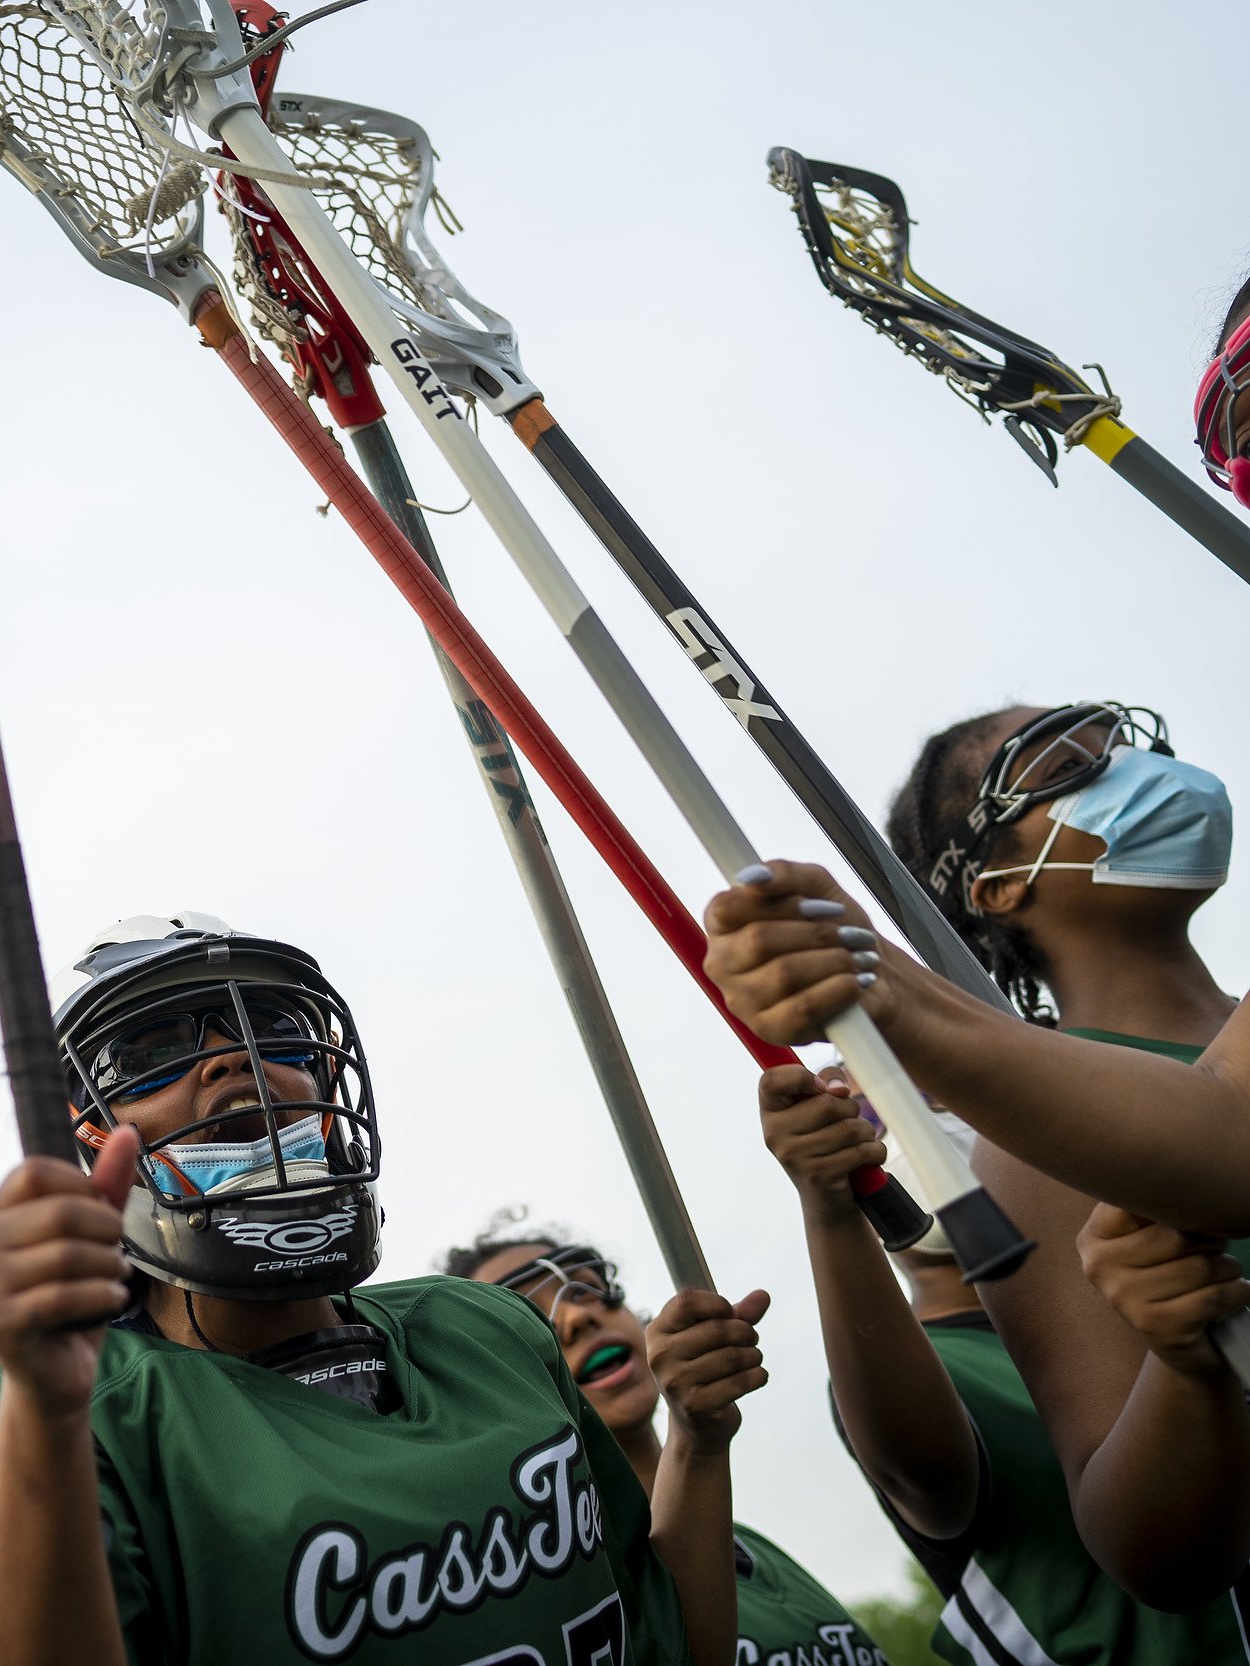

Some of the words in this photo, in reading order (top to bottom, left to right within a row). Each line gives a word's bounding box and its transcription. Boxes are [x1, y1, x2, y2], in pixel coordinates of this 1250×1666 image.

[279, 99, 303, 112] STX
[390, 338, 463, 420] GAIT
[664, 605, 784, 732] STX
[929, 837, 967, 897] STX
[253, 1251, 348, 1272] cascade
[294, 1357, 388, 1386] ascade
